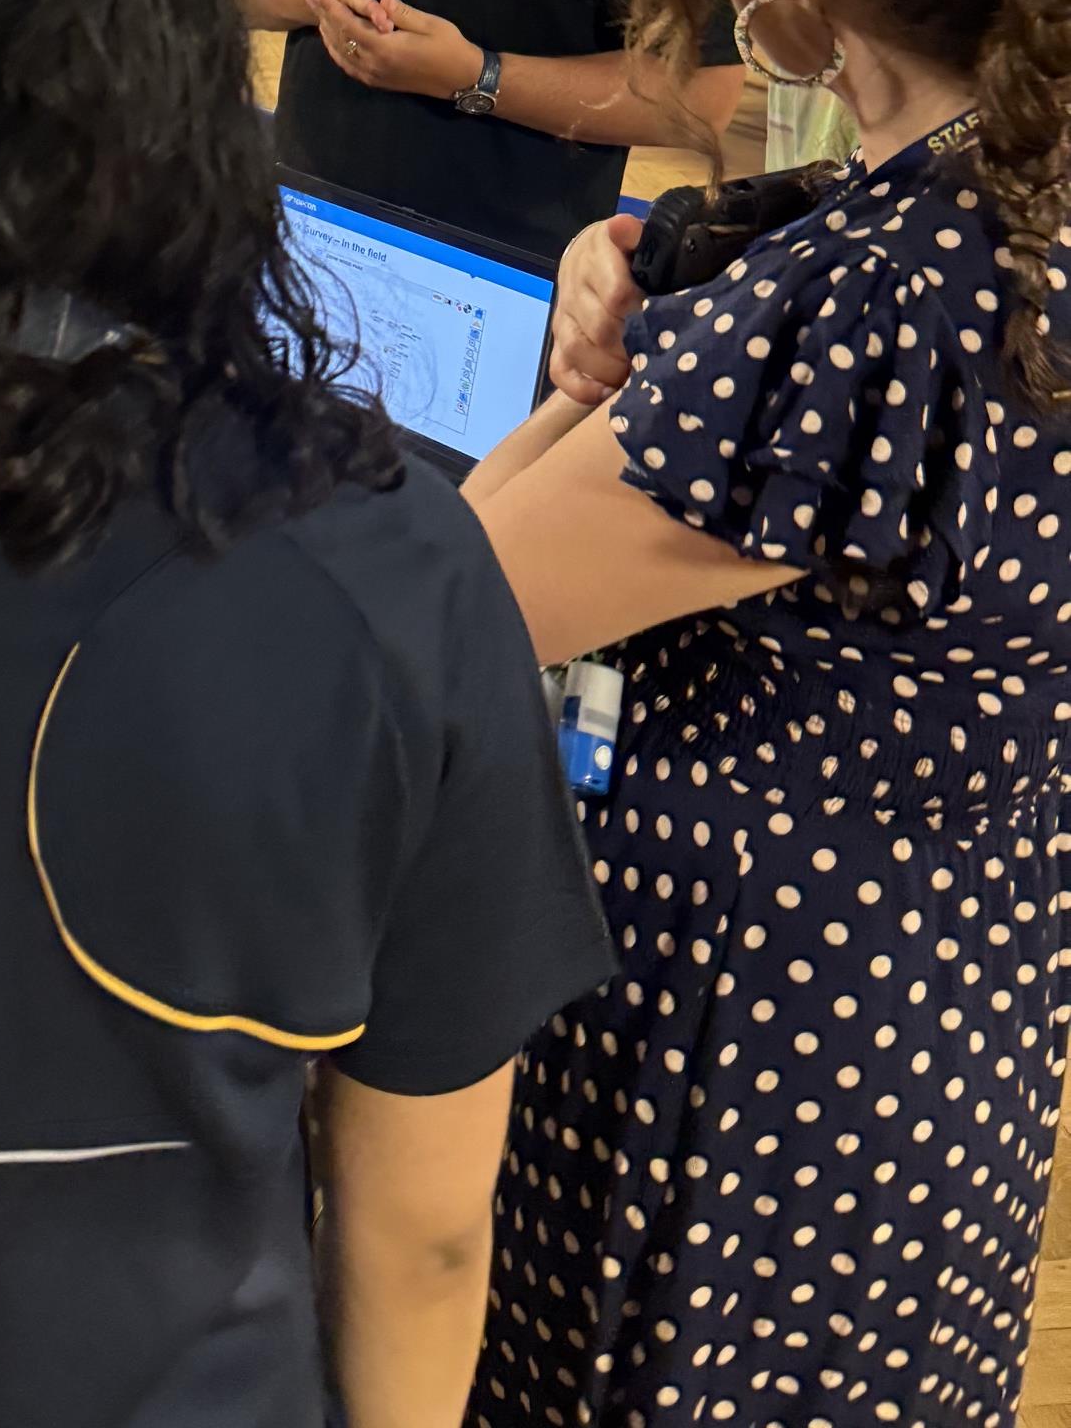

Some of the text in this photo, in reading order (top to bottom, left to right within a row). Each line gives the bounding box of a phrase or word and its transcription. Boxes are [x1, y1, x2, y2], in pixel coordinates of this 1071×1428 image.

[304, 224, 334, 244] Survey
[352, 242, 366, 255] the
[367, 247, 387, 263] field
